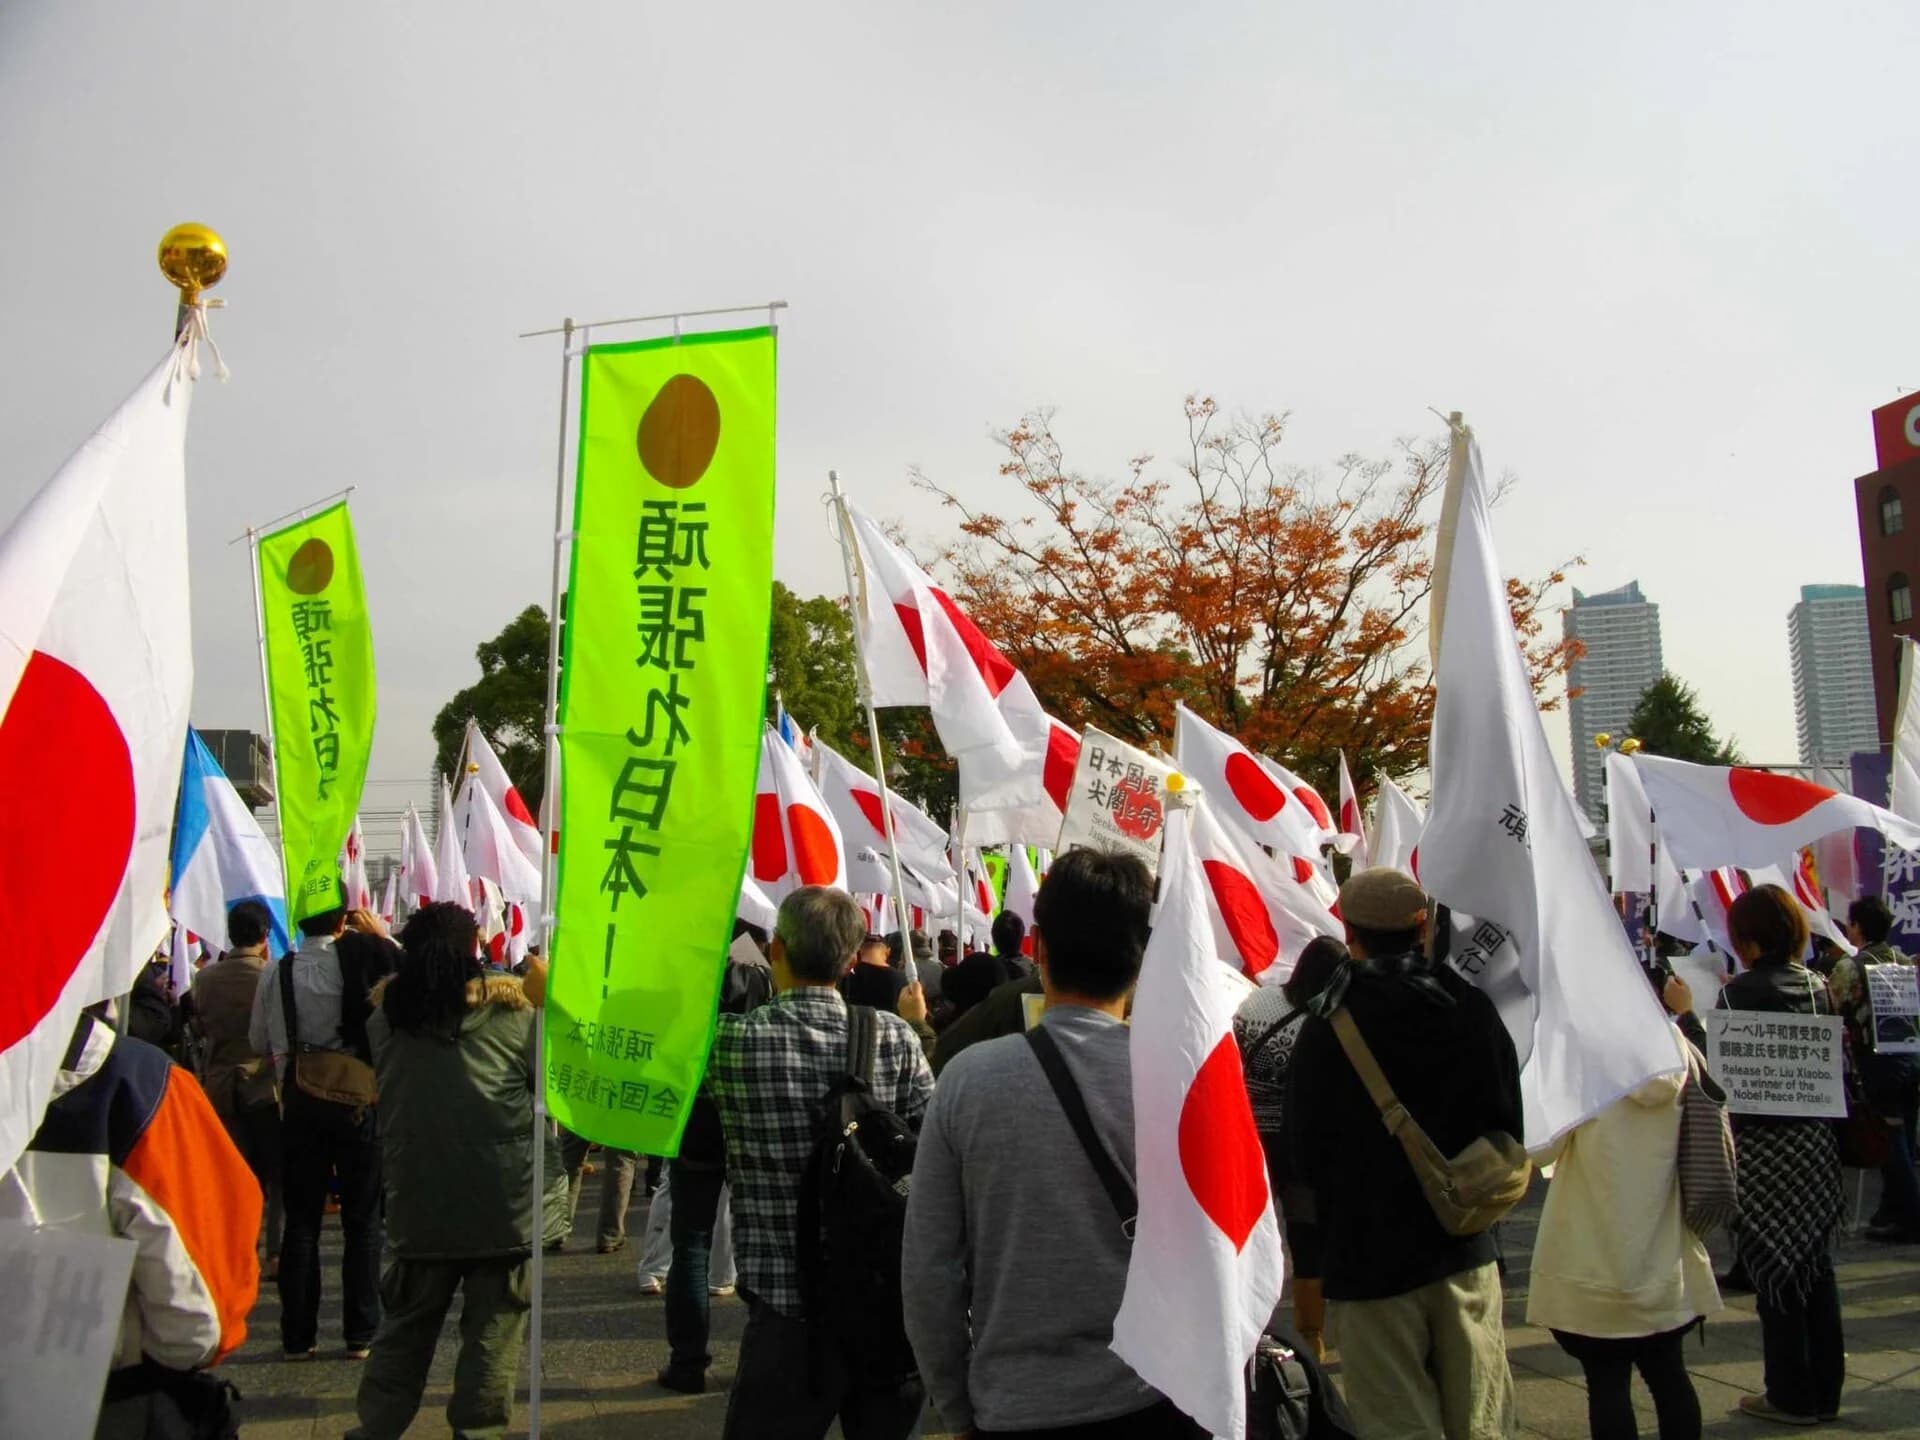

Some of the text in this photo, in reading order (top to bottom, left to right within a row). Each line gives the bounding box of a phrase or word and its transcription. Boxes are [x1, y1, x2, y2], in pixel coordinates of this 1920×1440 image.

[1498, 803, 1531, 849] 頑
[1722, 1064, 1761, 1077] Release
[1763, 1066, 1777, 1078] Dr.
[1780, 1067, 1794, 1078] Liu
[1751, 1079, 1783, 1089] winner
[1785, 1079, 1798, 1090] of
[1799, 1080, 1815, 1091] the
[1734, 1089, 1762, 1100] Nobel
[1764, 1090, 1794, 1102] Peace
